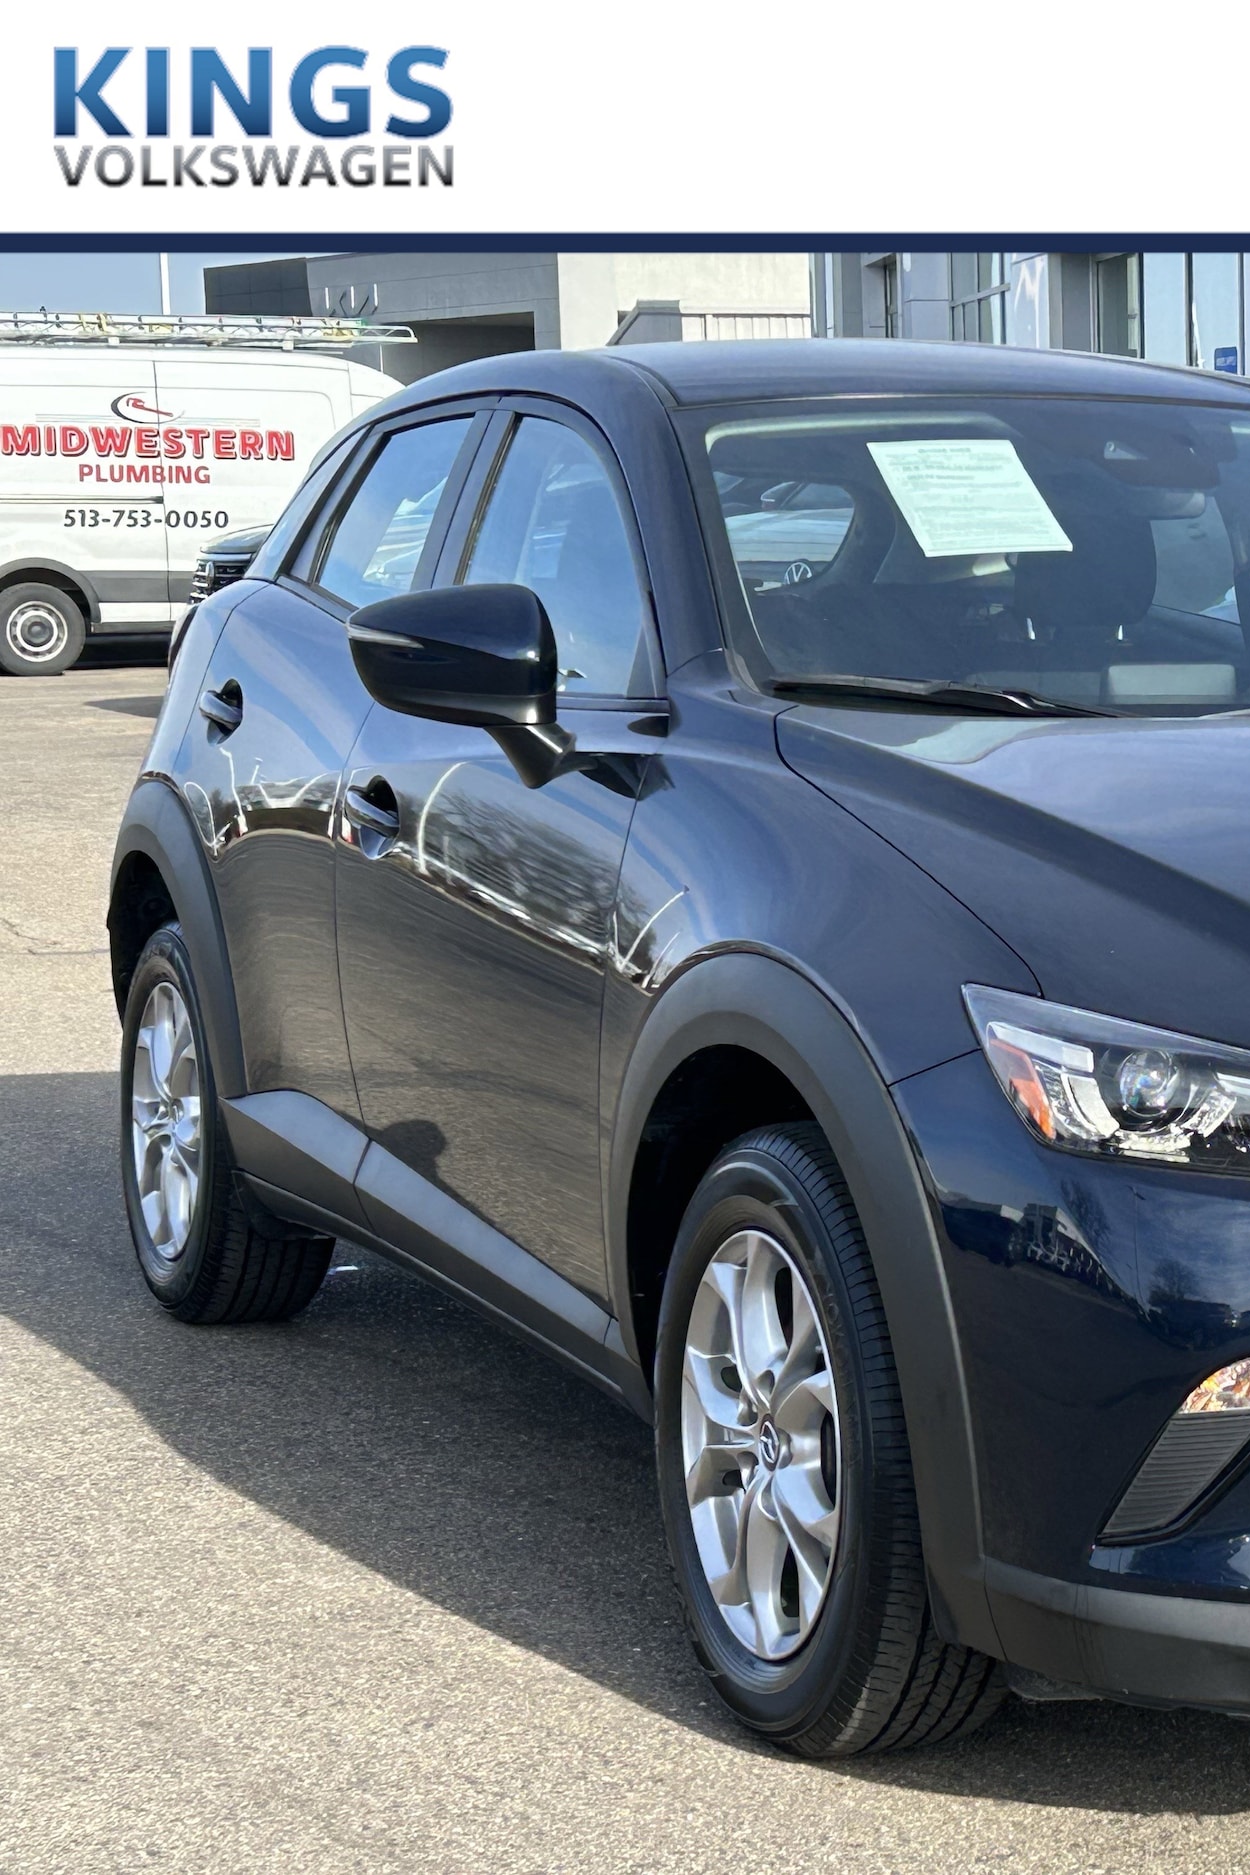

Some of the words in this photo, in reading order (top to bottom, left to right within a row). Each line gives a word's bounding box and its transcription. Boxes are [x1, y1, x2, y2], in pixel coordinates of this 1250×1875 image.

[1, 425, 295, 460] MIDWESTERN
[79, 464, 210, 484] PLUMBING
[63, 509, 229, 528] 513-753-0050
